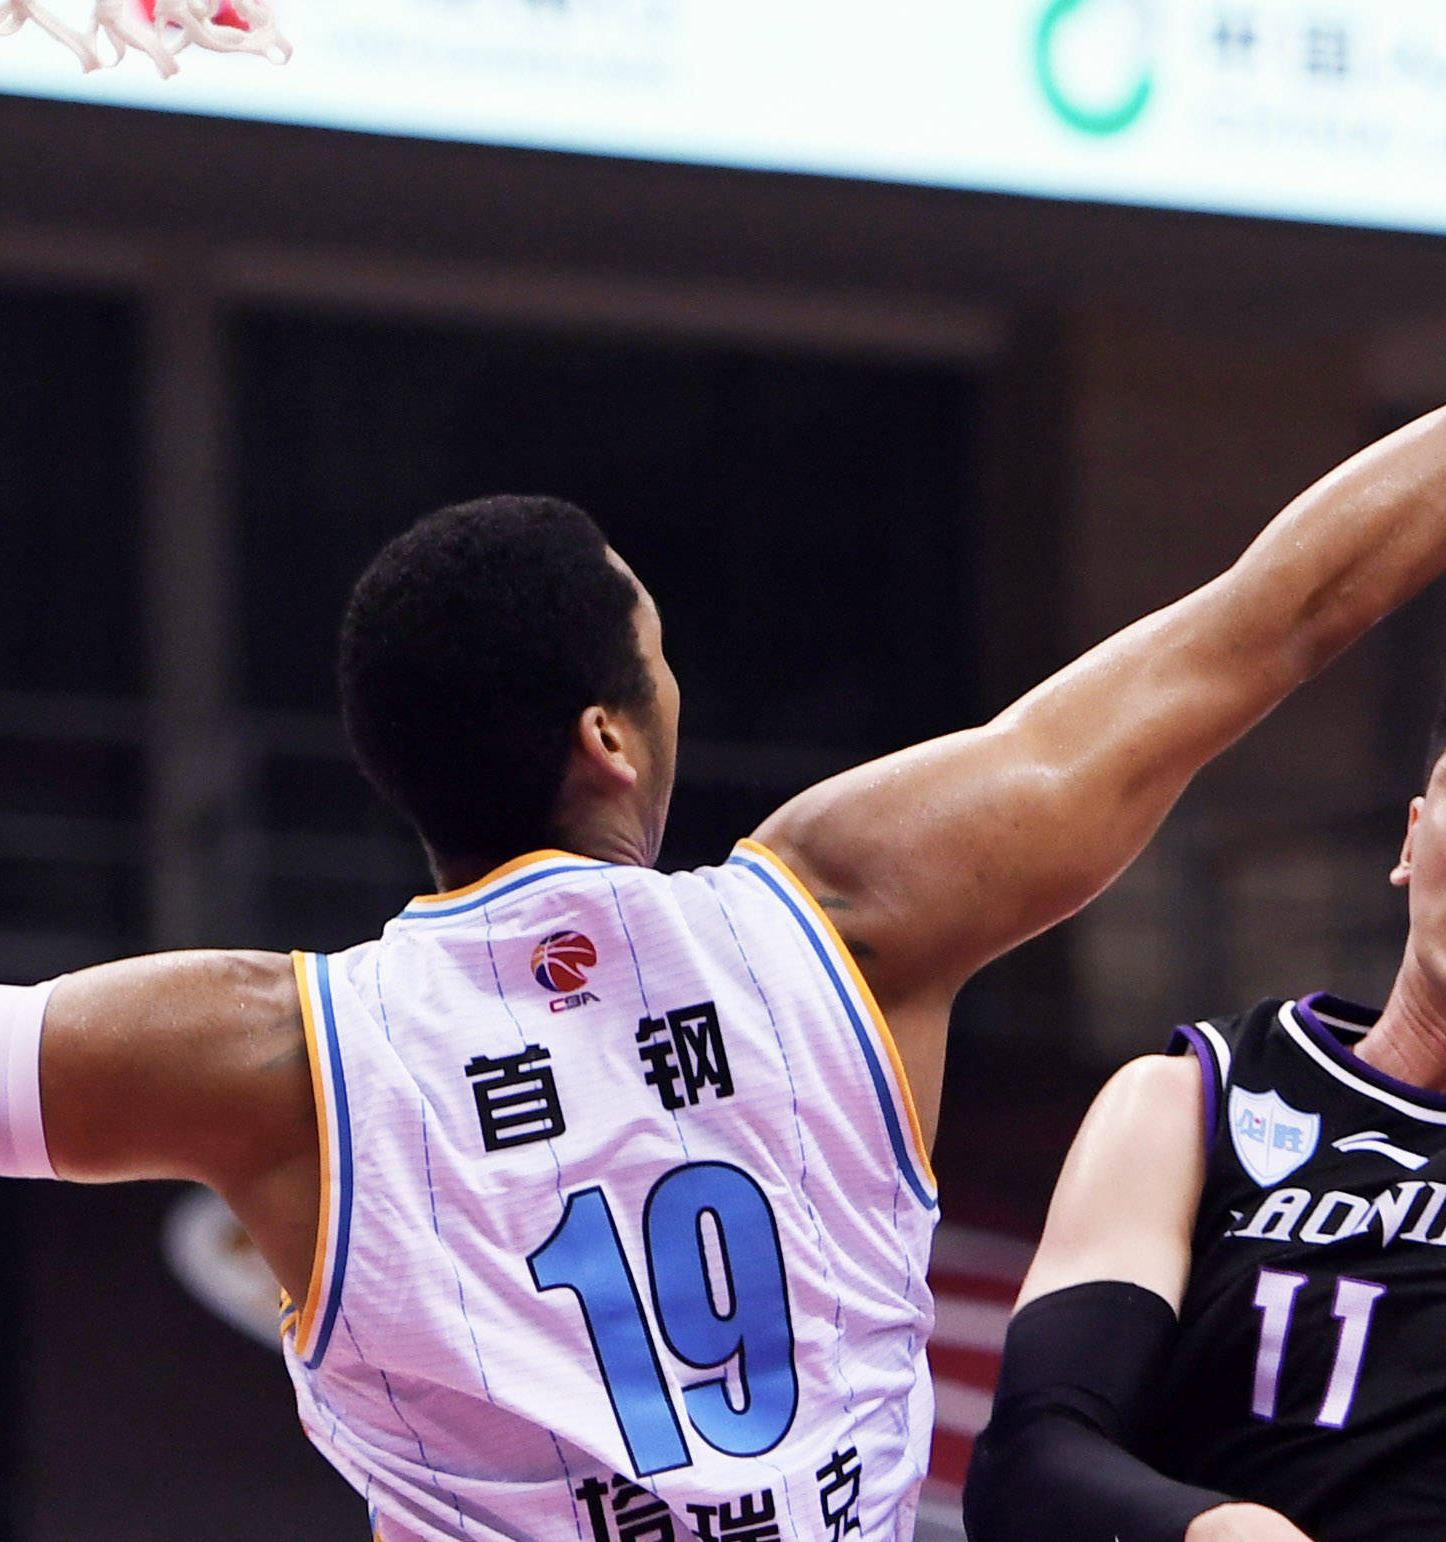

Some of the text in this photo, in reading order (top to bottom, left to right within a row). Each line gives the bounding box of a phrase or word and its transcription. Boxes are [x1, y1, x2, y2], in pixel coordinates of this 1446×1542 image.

[465, 1000, 735, 1152] 首钢
[526, 1160, 799, 1478] 19
[1251, 1267, 1387, 1429] 11
